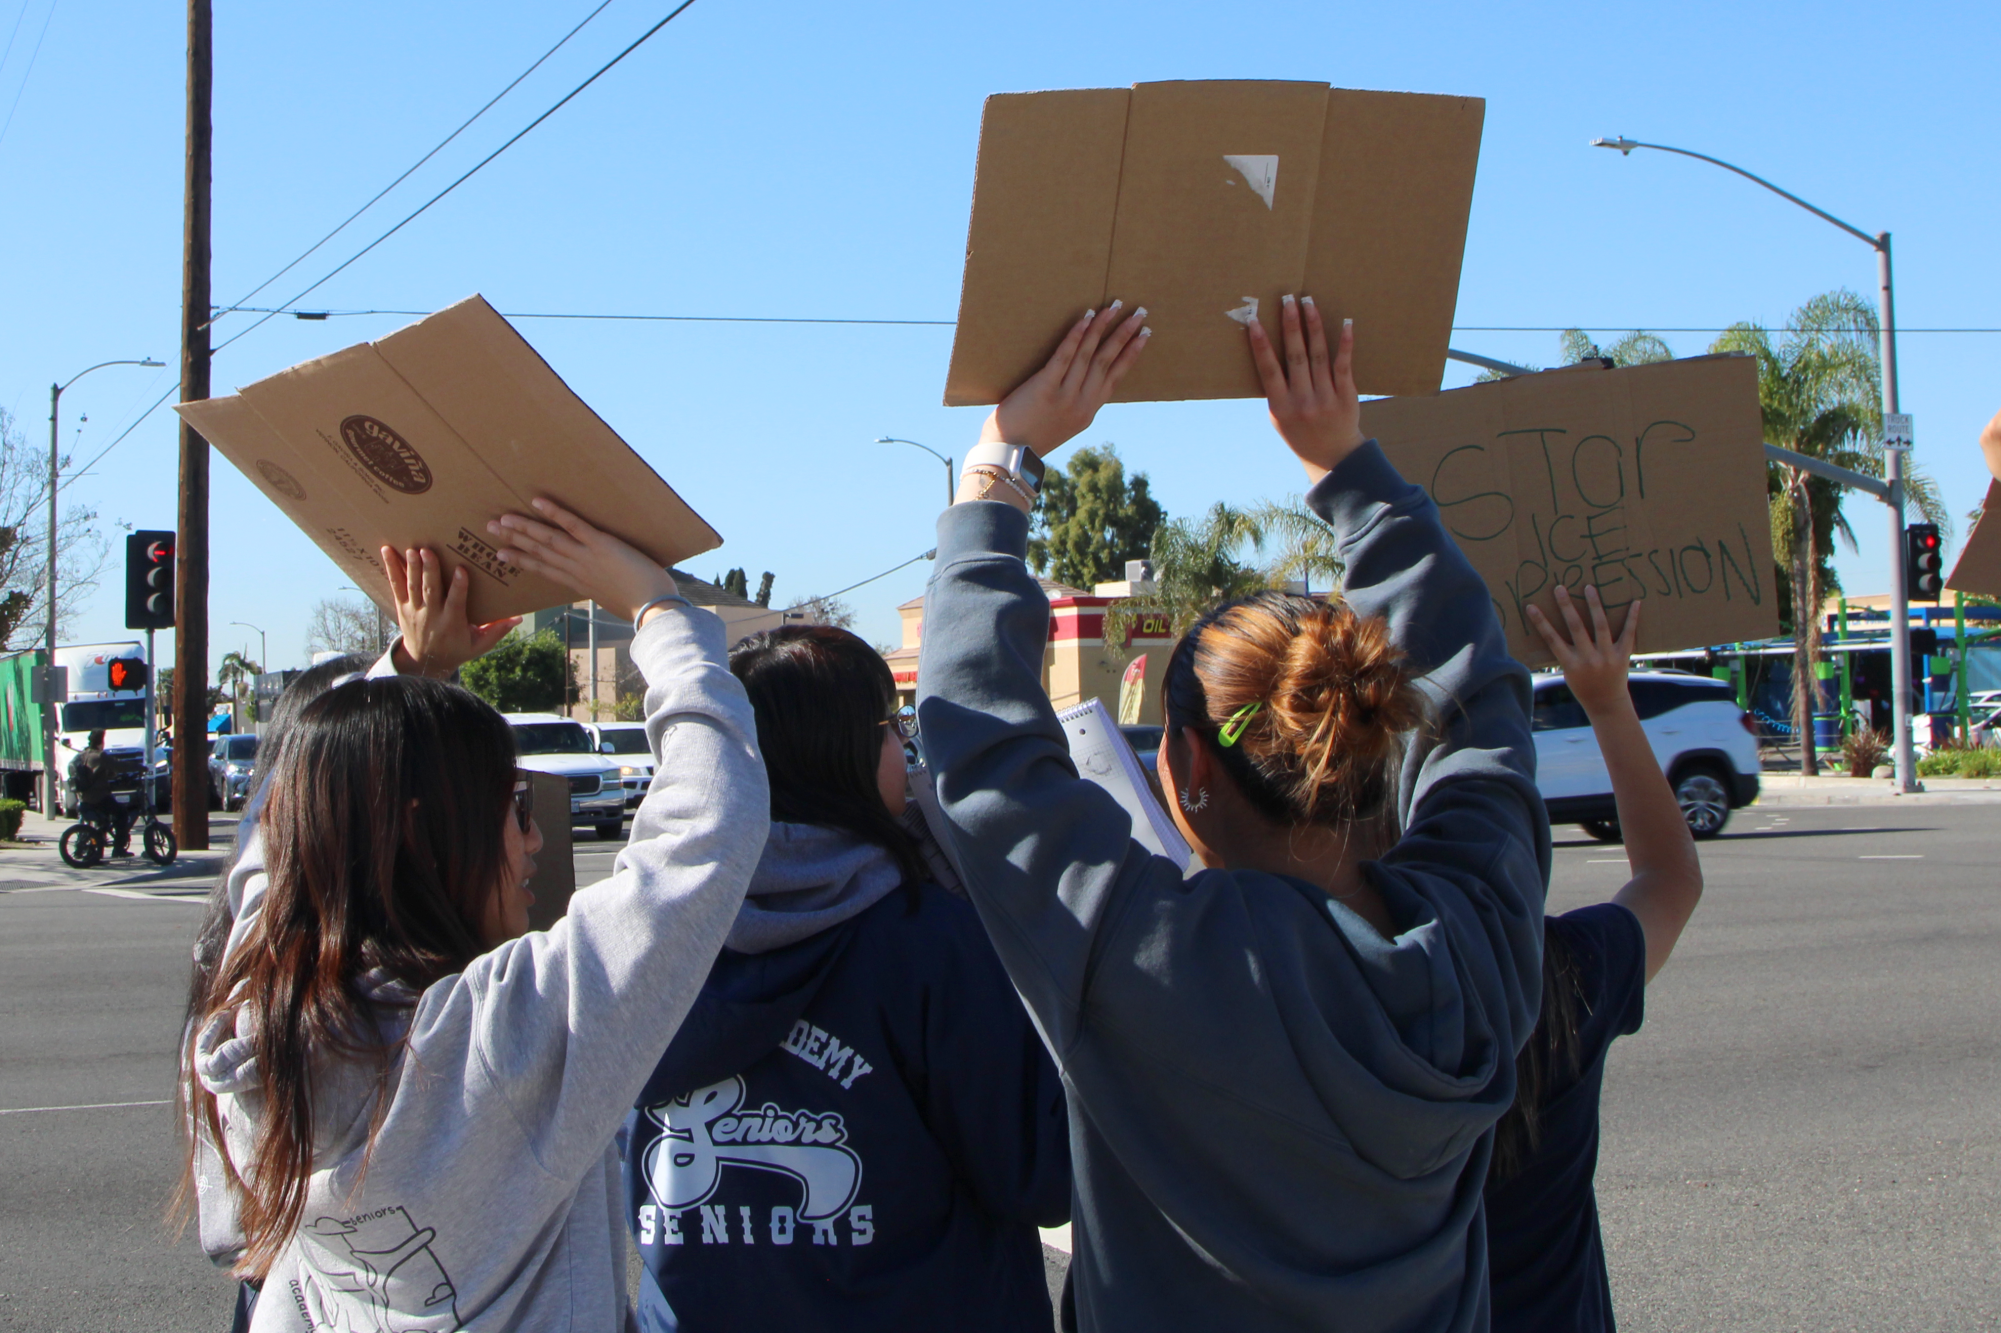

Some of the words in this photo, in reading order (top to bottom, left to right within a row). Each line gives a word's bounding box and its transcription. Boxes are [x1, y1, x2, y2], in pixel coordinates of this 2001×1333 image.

[1887, 415, 1908, 425] TRUCK
[1887, 425, 1908, 434] ROUTE
[364, 420, 426, 483] gaviña
[373, 466, 405, 488] coffee
[457, 530, 523, 576] WHOLE
[1531, 507, 1630, 569] ICE
[455, 542, 508, 579] BEAN
[1142, 619, 1167, 633] OIL
[778, 1019, 873, 1089] DEMY
[638, 1205, 875, 1246] SENIORS
